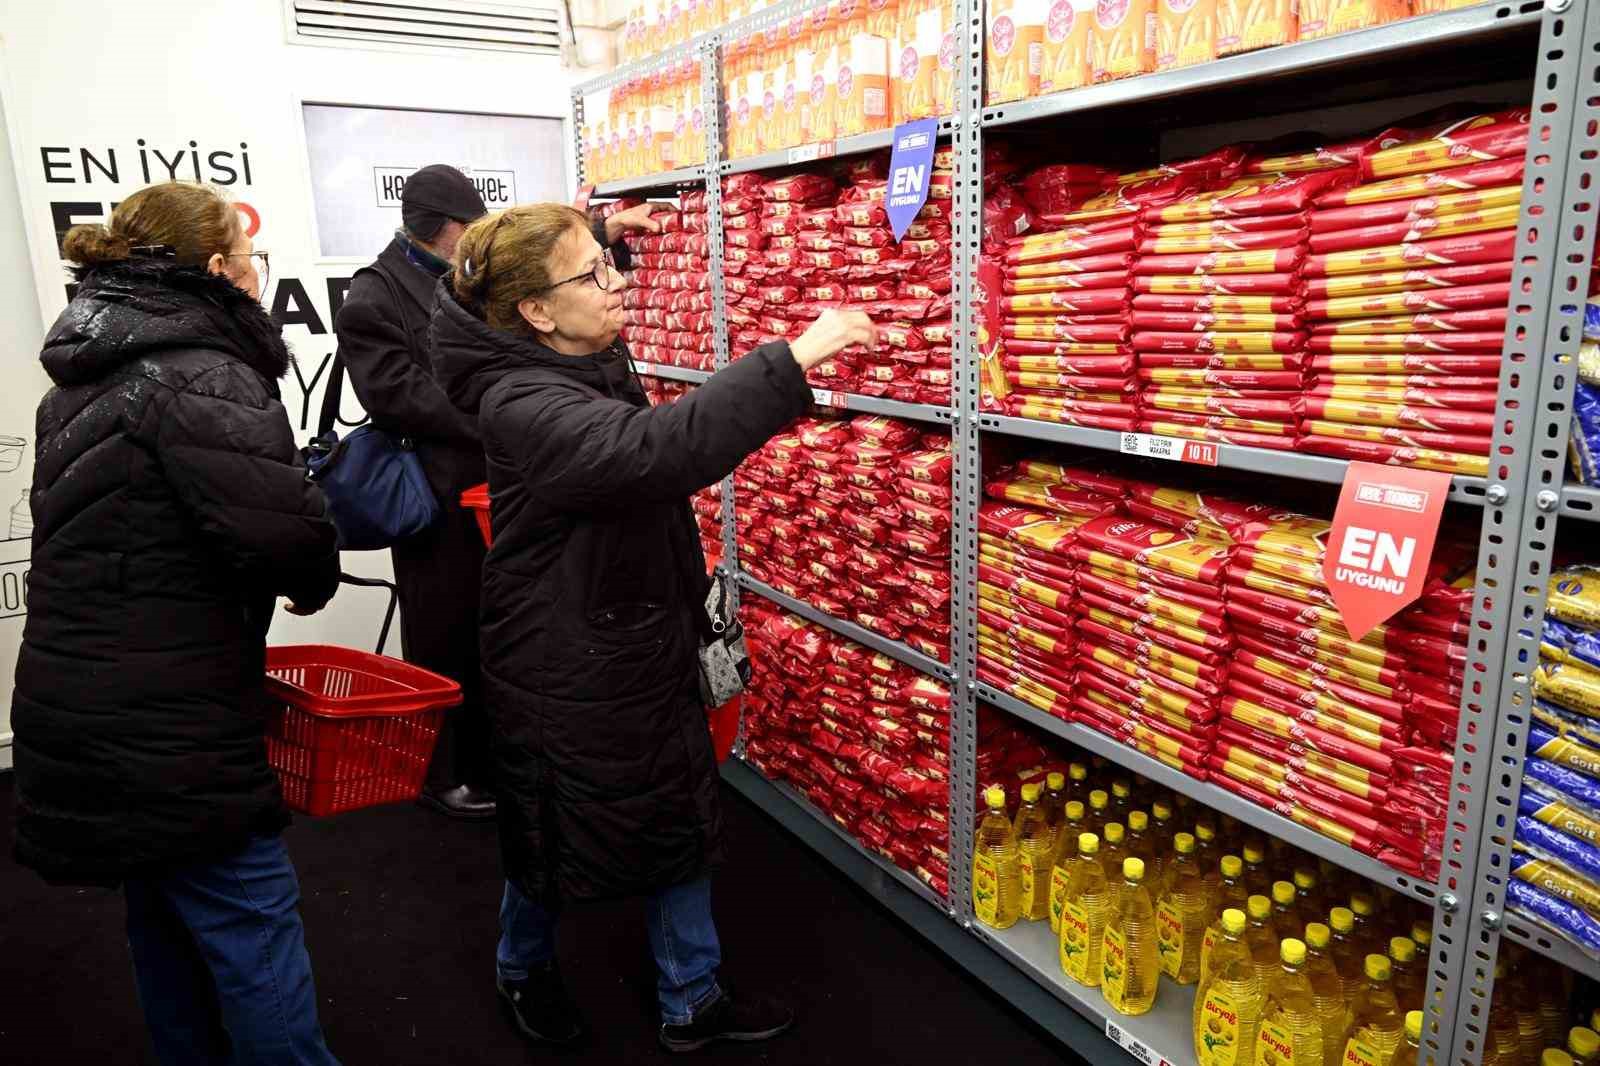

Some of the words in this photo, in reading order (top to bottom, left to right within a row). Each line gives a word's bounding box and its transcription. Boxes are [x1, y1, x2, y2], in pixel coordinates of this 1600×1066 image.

[40, 147, 120, 184] EN
[892, 164, 926, 196] EN
[1188, 443, 1200, 460] 10
[1202, 446, 1214, 462] TL
[1338, 525, 1417, 578] EN
[1335, 566, 1406, 595] UYGUNU
[1205, 1000, 1238, 1026] Biryağ
[1261, 1030, 1293, 1060] Biryağ
